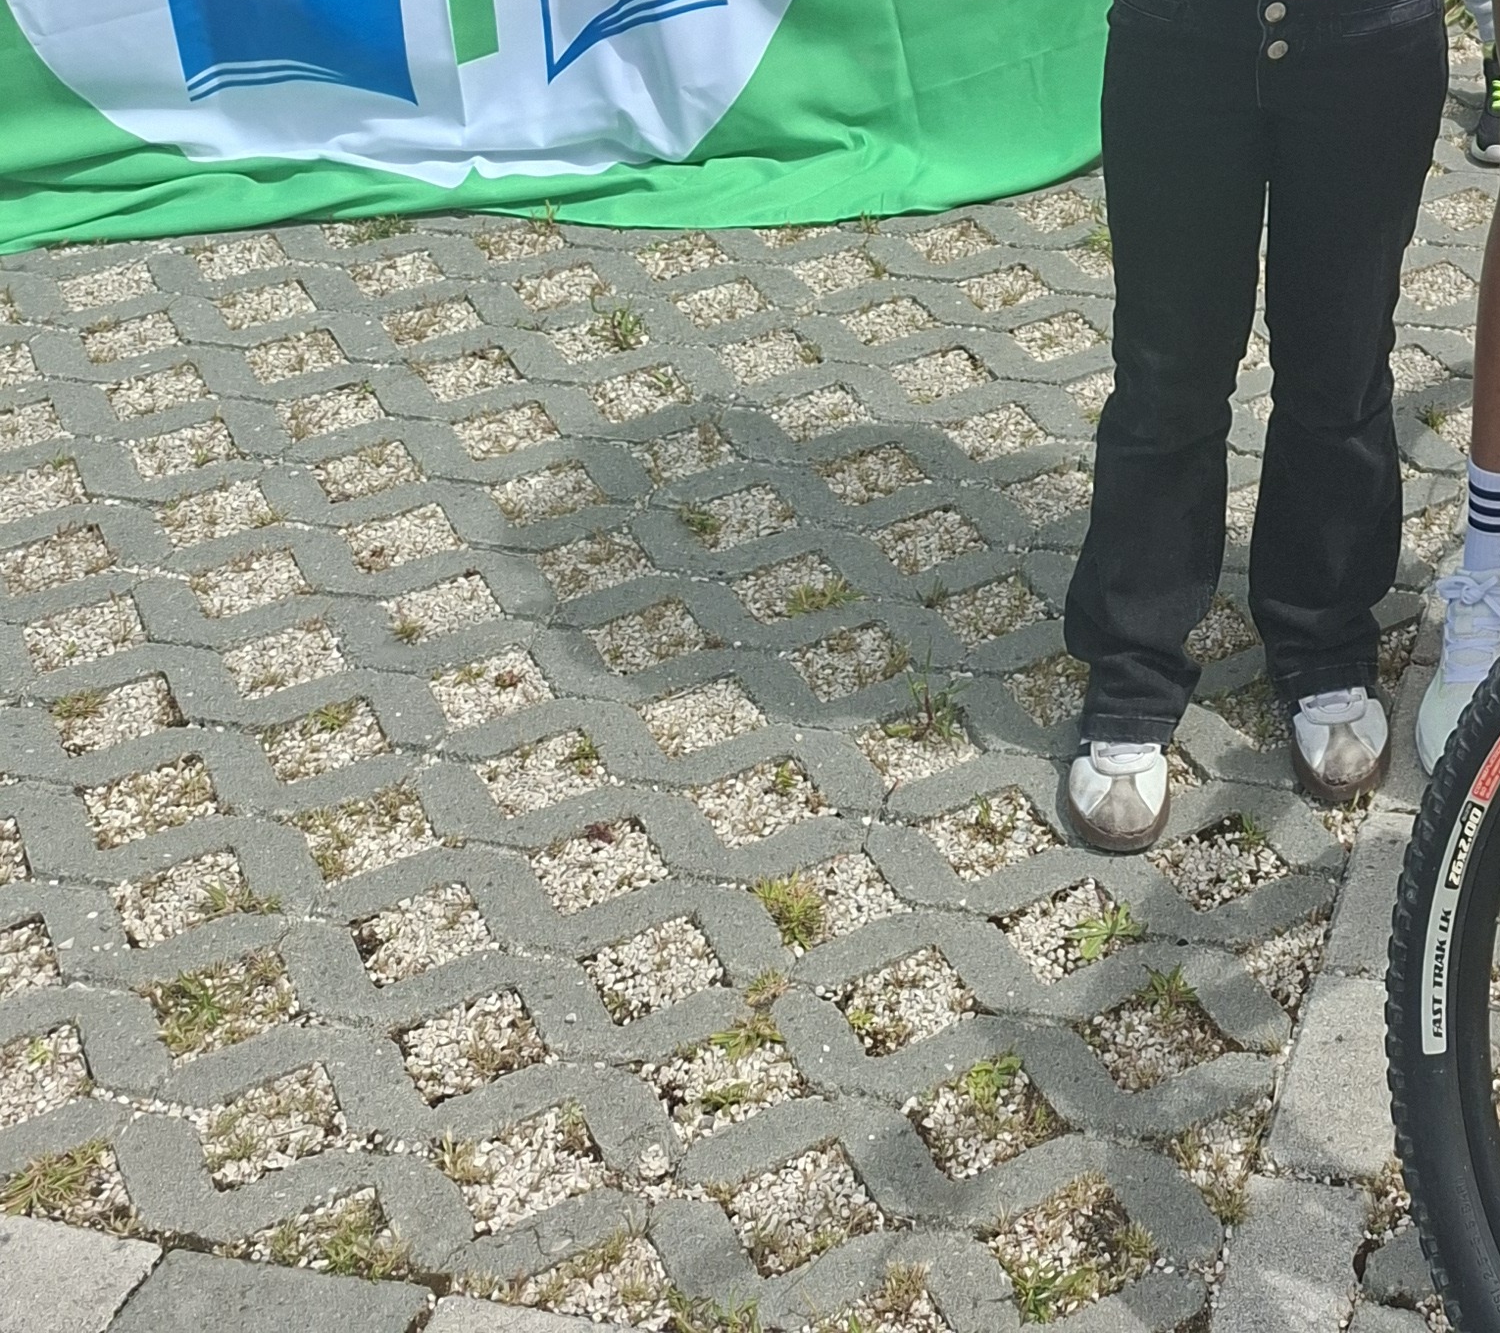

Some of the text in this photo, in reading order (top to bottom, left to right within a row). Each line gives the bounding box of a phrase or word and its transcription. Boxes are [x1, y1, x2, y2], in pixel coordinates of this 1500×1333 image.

[1432, 907, 1453, 1038] FAST TRAK LK
